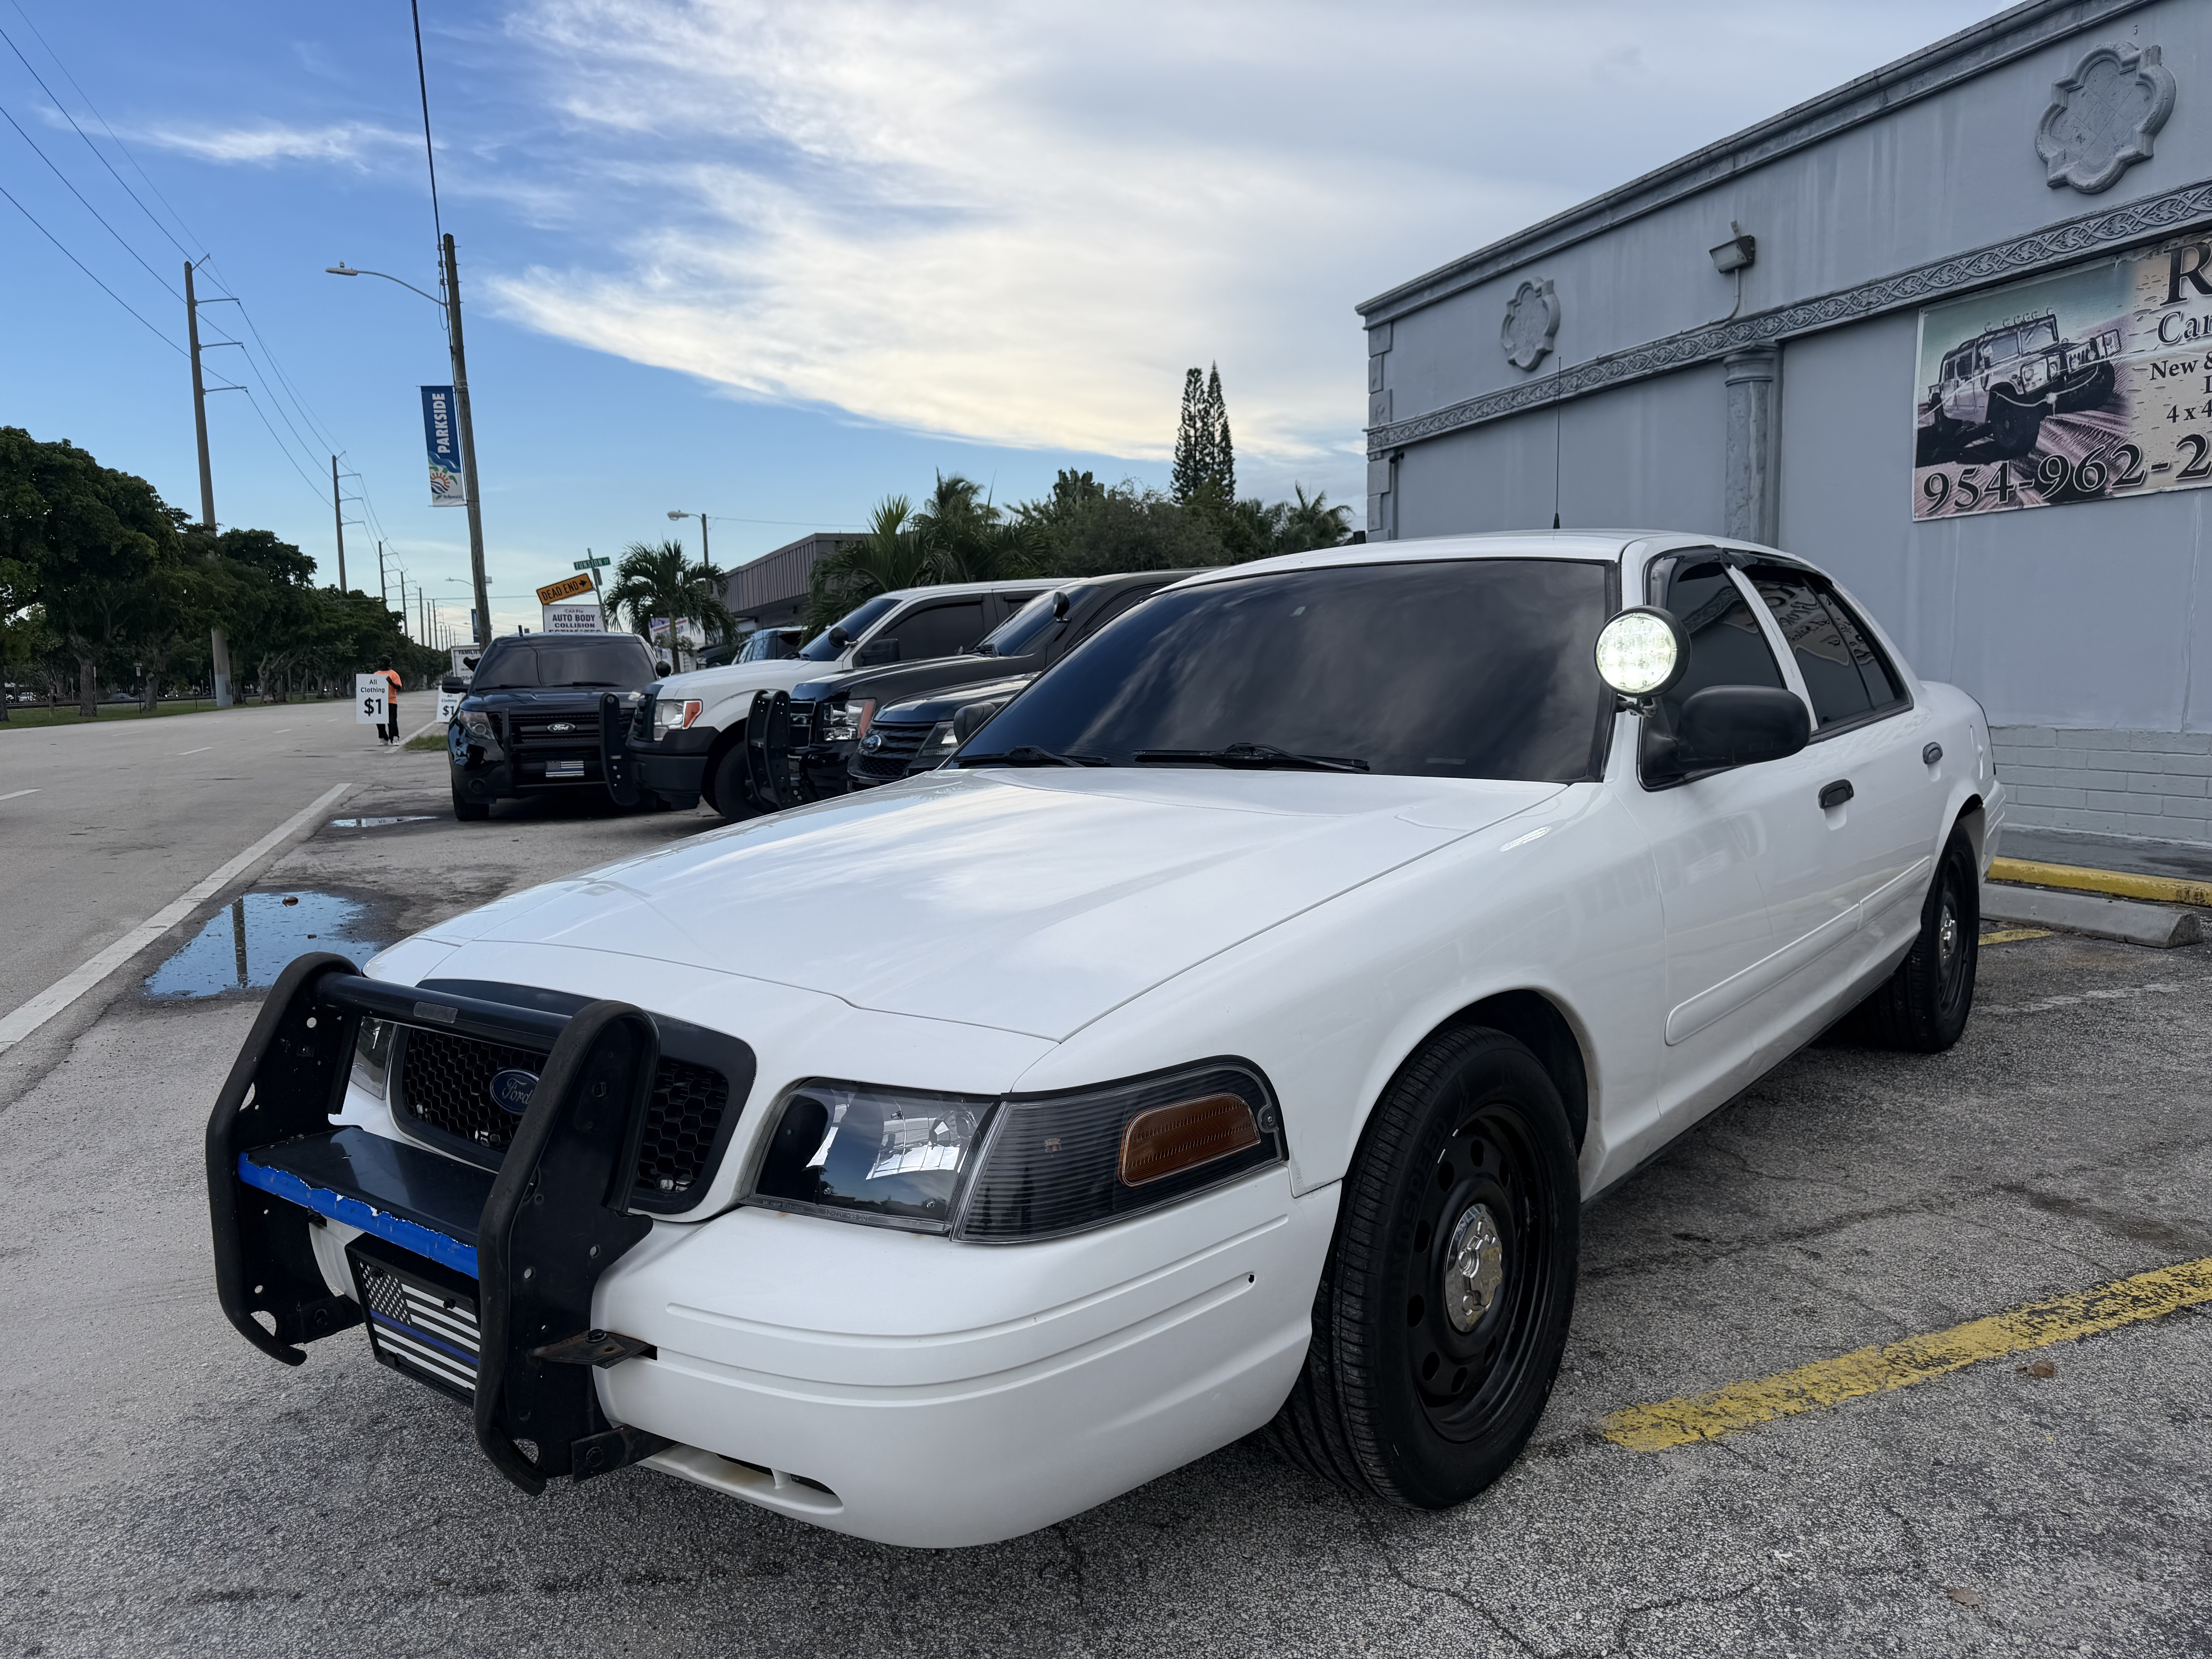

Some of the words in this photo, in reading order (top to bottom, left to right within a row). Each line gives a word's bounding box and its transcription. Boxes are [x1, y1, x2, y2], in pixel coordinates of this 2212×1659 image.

[2149, 359, 2198, 381] New
[432, 393, 451, 453] PARKSIDE
[1923, 433, 2212, 514] 954-962-2
[541, 586, 562, 601] DEAD
[563, 581, 579, 593] END
[364, 697, 381, 716] $1
[443, 705, 454, 717] $1
[502, 1078, 533, 1105] Ford
